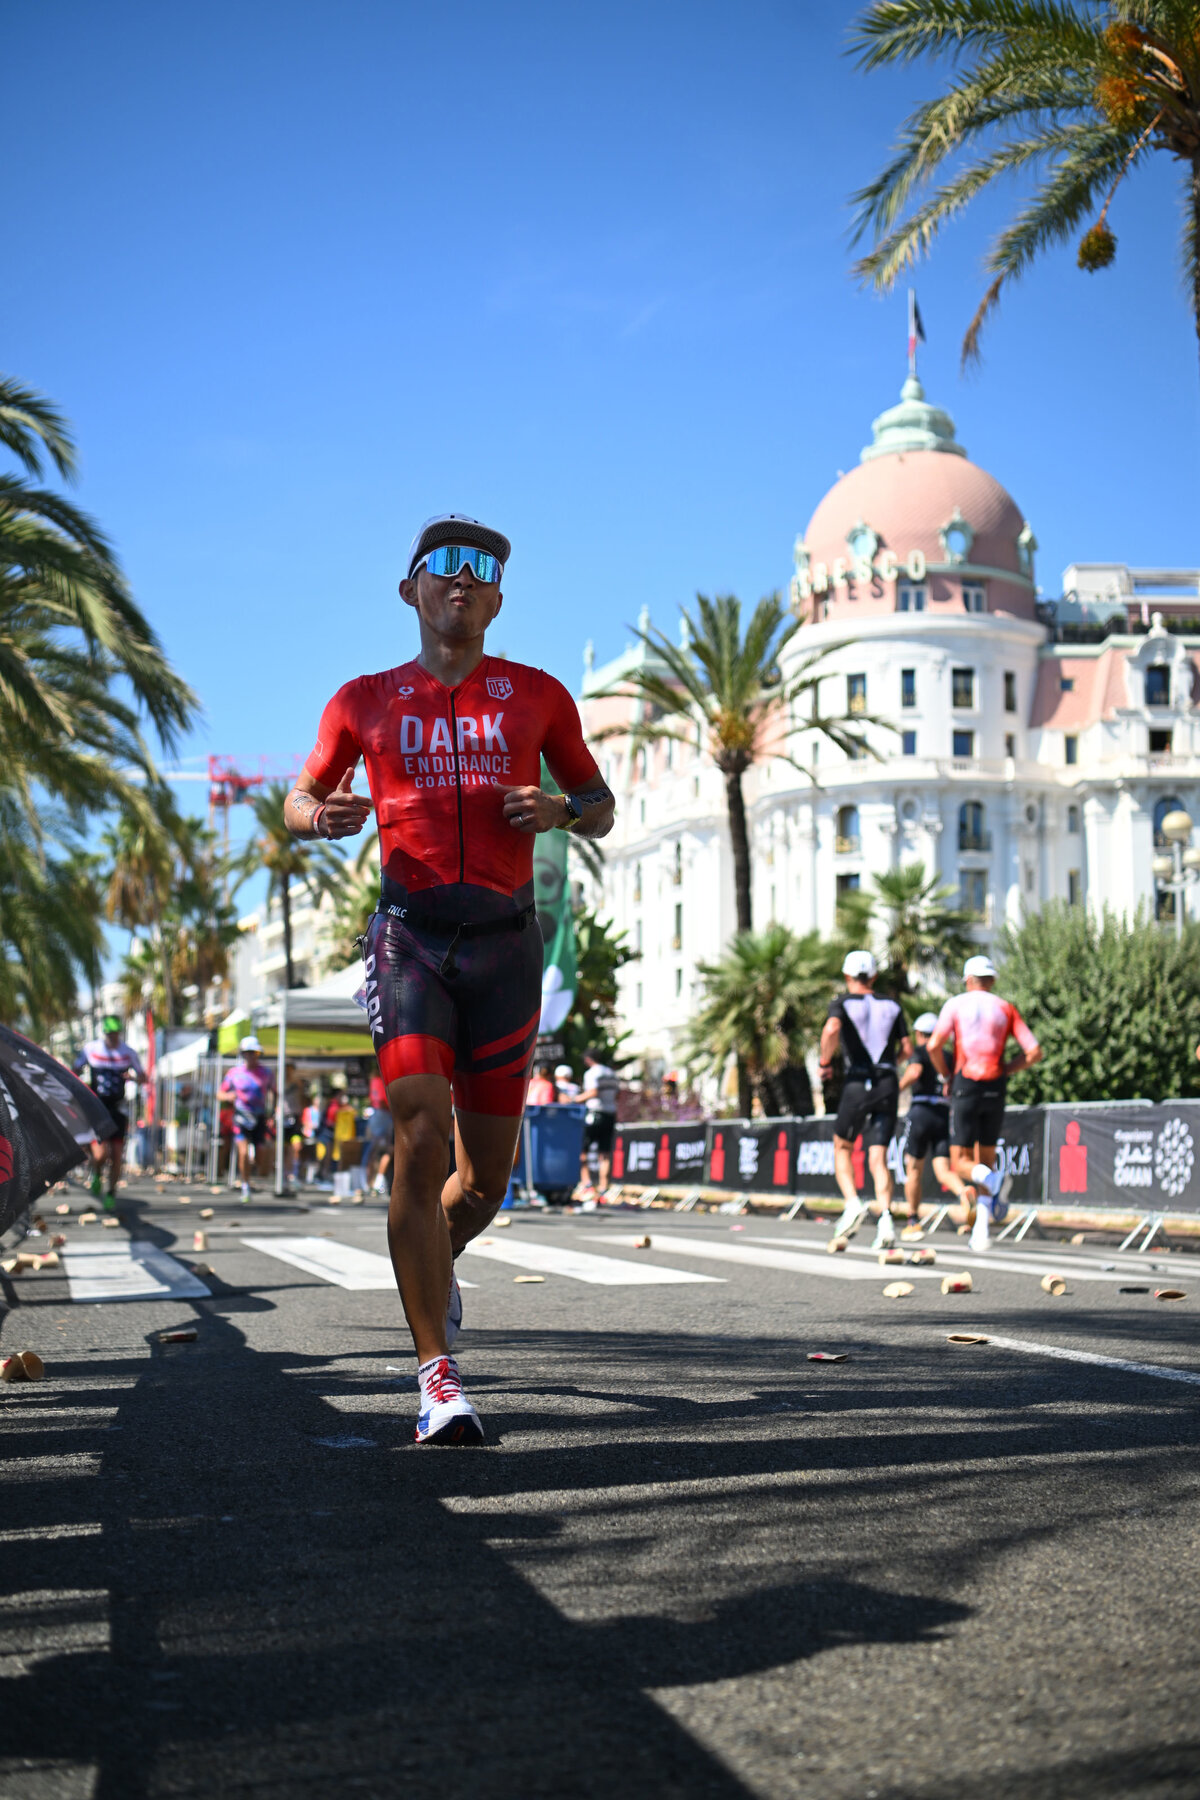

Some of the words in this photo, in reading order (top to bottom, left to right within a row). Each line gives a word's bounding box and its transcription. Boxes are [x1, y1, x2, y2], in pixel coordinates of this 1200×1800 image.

[487, 679, 513, 698] DEC
[400, 712, 509, 754] DARK
[404, 754, 511, 774] ENDURANCE
[415, 774, 498, 788] COACHING
[365, 953, 384, 1043] DARK
